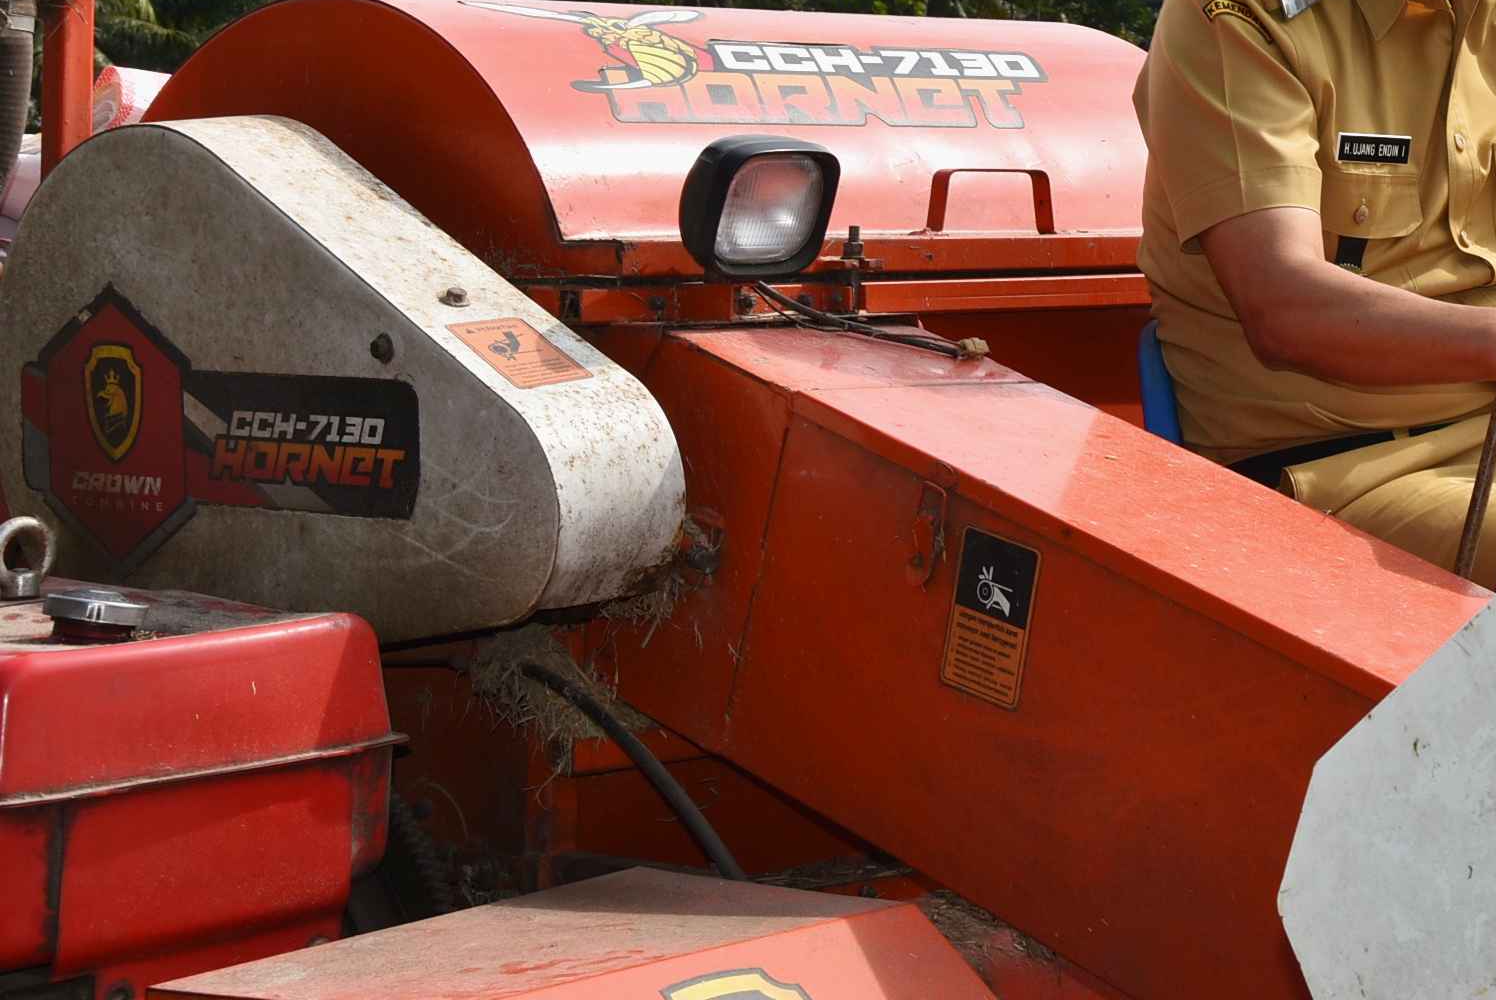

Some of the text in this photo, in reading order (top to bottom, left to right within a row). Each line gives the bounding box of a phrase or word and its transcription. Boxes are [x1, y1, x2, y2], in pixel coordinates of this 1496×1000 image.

[715, 43, 1041, 79] CCH-7130
[1378, 143, 1400, 158] ENDIN
[230, 410, 385, 445] CCH-7130
[71, 471, 162, 496] CROWN
